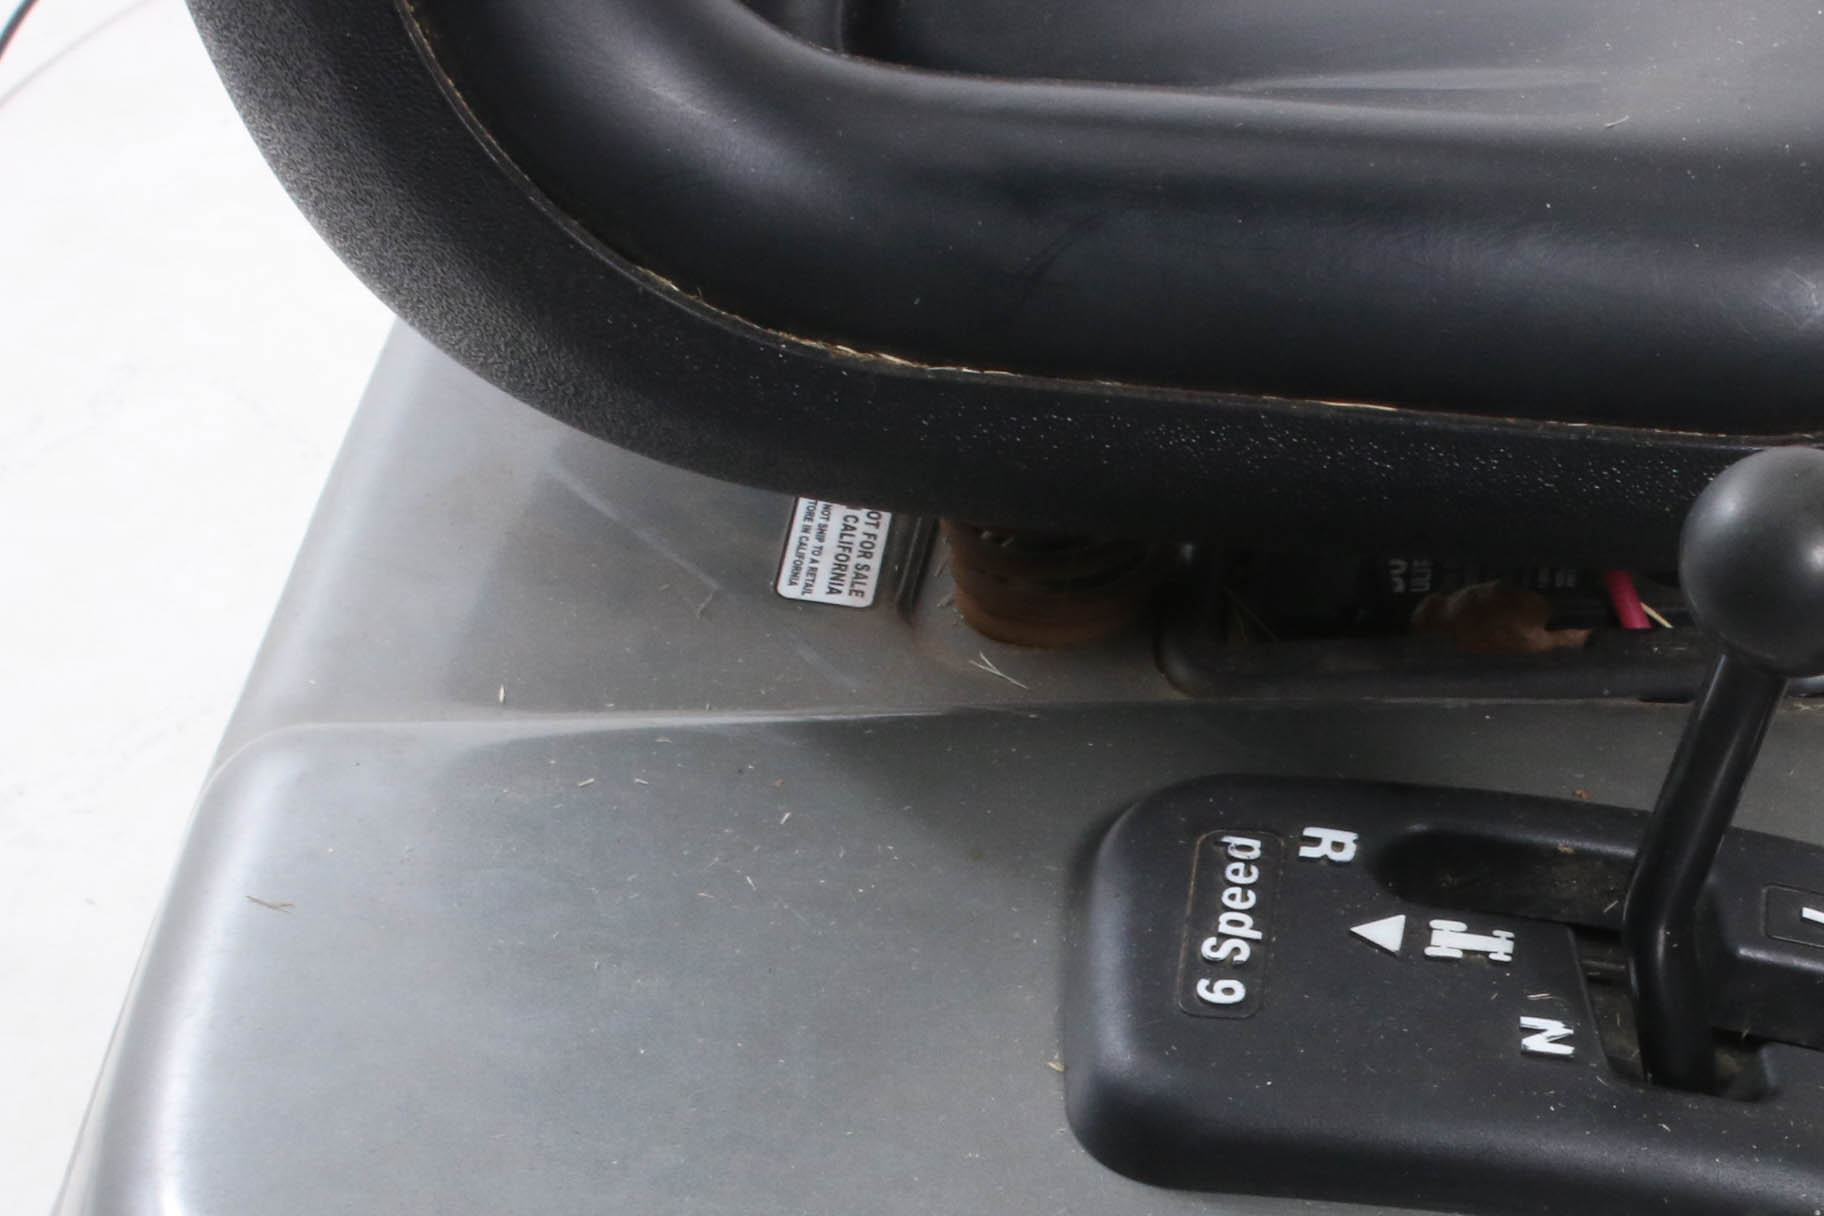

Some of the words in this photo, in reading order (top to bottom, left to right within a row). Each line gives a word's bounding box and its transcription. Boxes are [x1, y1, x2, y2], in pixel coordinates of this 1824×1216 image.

[804, 501, 817, 522] TORE
[820, 504, 831, 521] NOT
[865, 511, 882, 529] OT
[801, 525, 810, 533] IN
[817, 523, 828, 543] SHIP
[812, 546, 823, 556] TO
[826, 515, 859, 595] CALIFORNIA
[857, 532, 877, 559] FOR
[788, 536, 809, 586] CALIFORNIA
[802, 567, 817, 596] RETAIL
[849, 564, 870, 598] SALE
[1298, 826, 1358, 863] R
[1200, 835, 1263, 962] Speed
[1195, 977, 1246, 1004] 6
[1519, 1015, 1577, 1055] N
